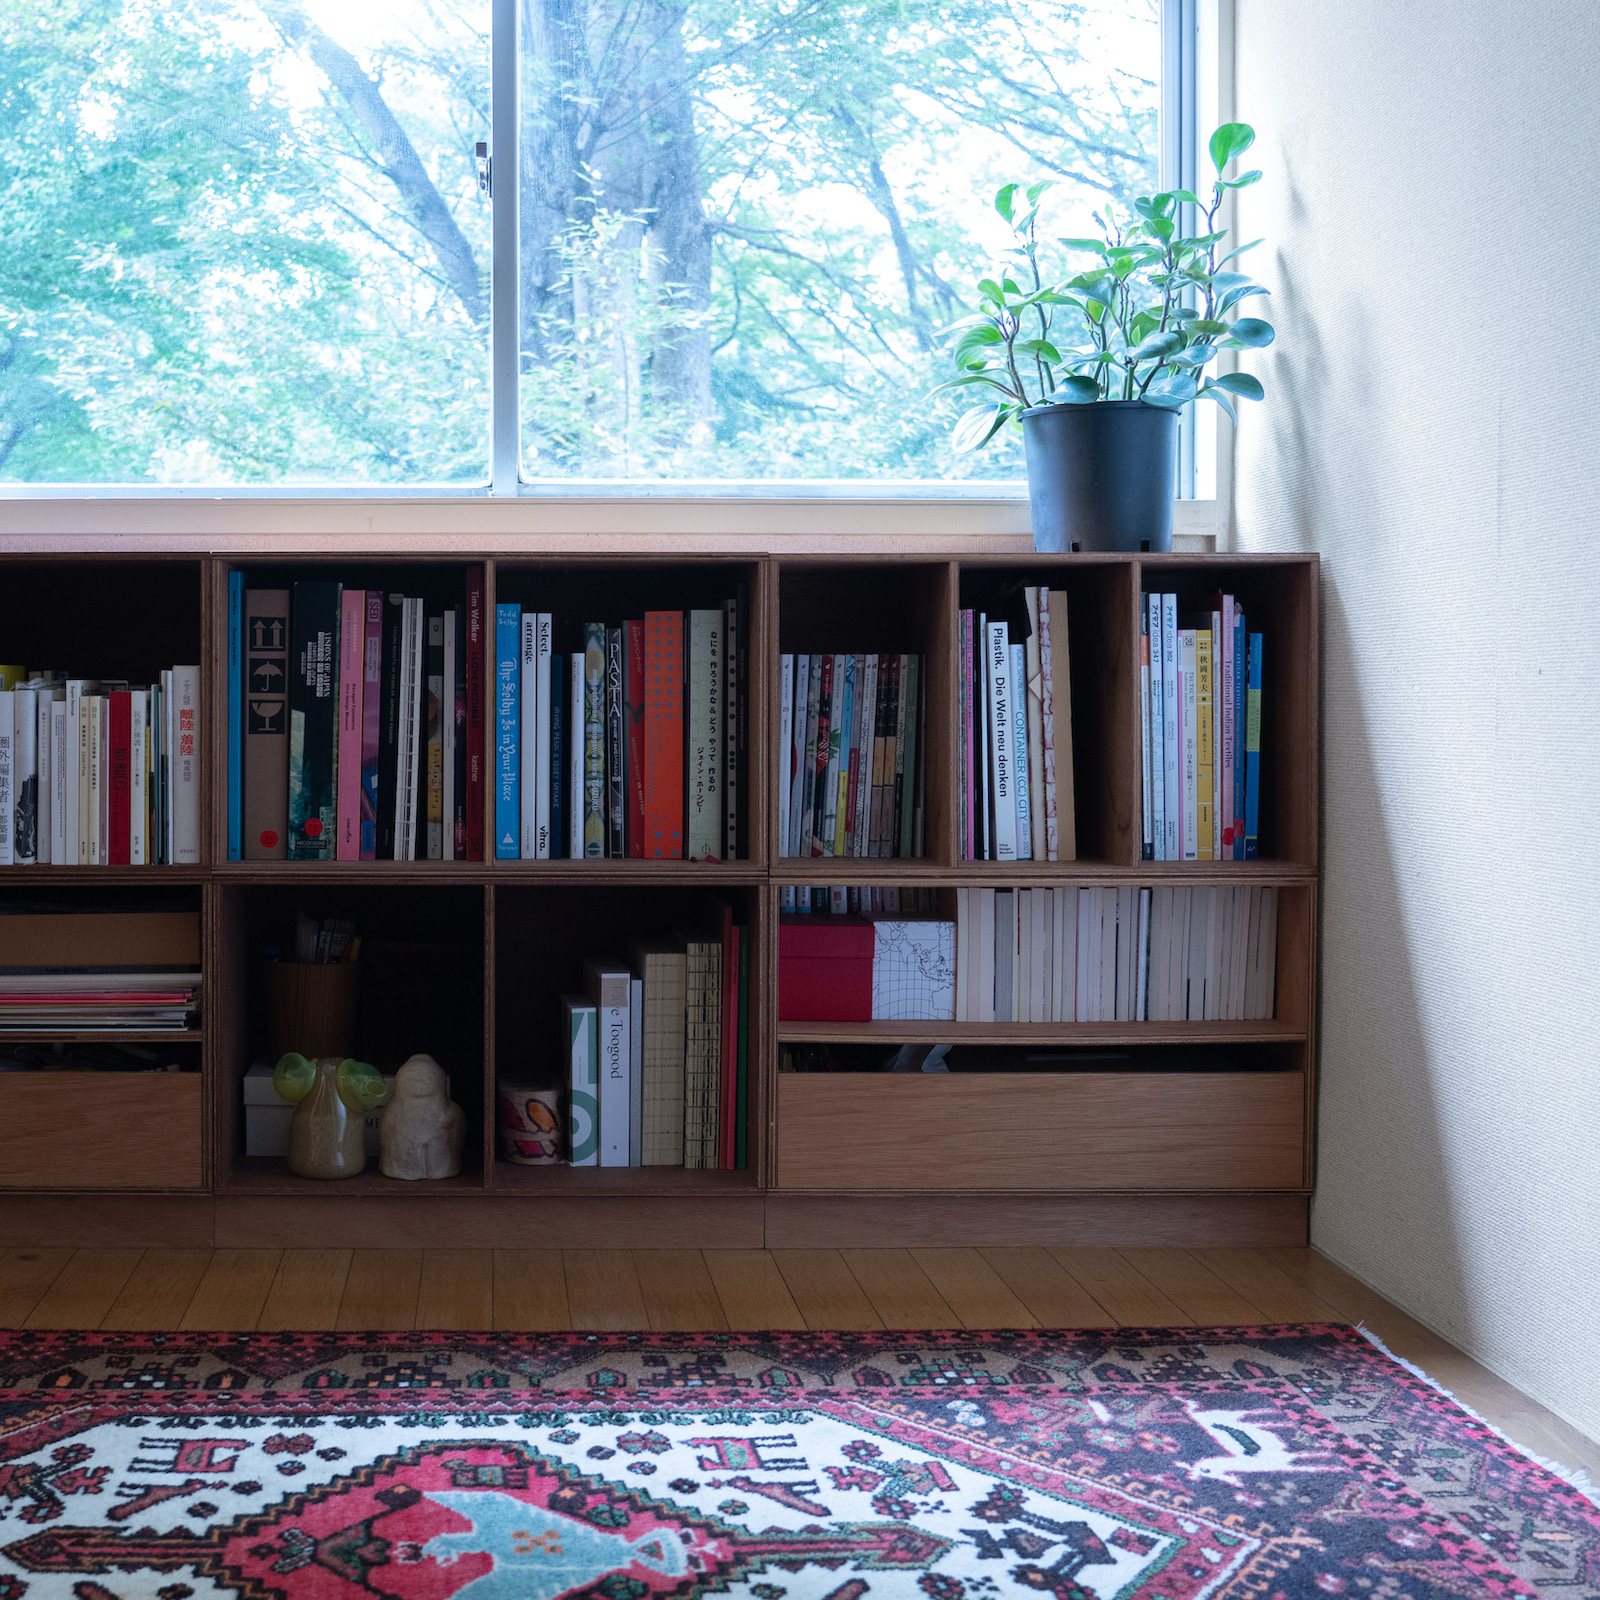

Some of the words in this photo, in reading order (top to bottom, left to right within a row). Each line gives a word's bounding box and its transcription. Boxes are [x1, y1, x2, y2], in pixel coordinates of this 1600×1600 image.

[369, 601, 379, 620] SED
[471, 590, 479, 607] Tim
[471, 608, 479, 643] Walker
[540, 622, 550, 656] Select.
[1152, 629, 1160, 648] idea
[1166, 630, 1175, 648] idea
[524, 622, 534, 665] arrange.
[994, 627, 1004, 670] Plastik.
[324, 662, 331, 673] OF
[471, 656, 479, 681] LOVE
[499, 657, 518, 682] The
[608, 642, 621, 718] PASTA
[1199, 655, 1208, 692] 秋岡芳夫
[995, 677, 1005, 695] Die
[1224, 659, 1233, 705] Traditional
[499, 682, 516, 716] Selby
[996, 699, 1006, 726] Welt
[179, 709, 196, 731] 離陸
[553, 706, 561, 730] IRVING
[1224, 707, 1233, 735] Indian
[1248, 700, 1257, 743] TEXTILES
[113, 747, 127, 761] NO
[179, 733, 196, 757] 着陸
[998, 730, 1006, 753] neu
[1015, 711, 1026, 773] CONTAINER
[1224, 736, 1233, 769] Textiles
[113, 762, 127, 792] RULES
[552, 760, 560, 780] ISSEY
[999, 754, 1008, 797] denken
[552, 781, 560, 809] MIYAKE
[591, 778, 599, 811] TSUZUKU
[1016, 775, 1027, 798] (CC)
[637, 790, 645, 816] MOTION
[1018, 799, 1028, 821] CITY
[539, 825, 549, 852] vitra.
[606, 1020, 624, 1080] Toogood
